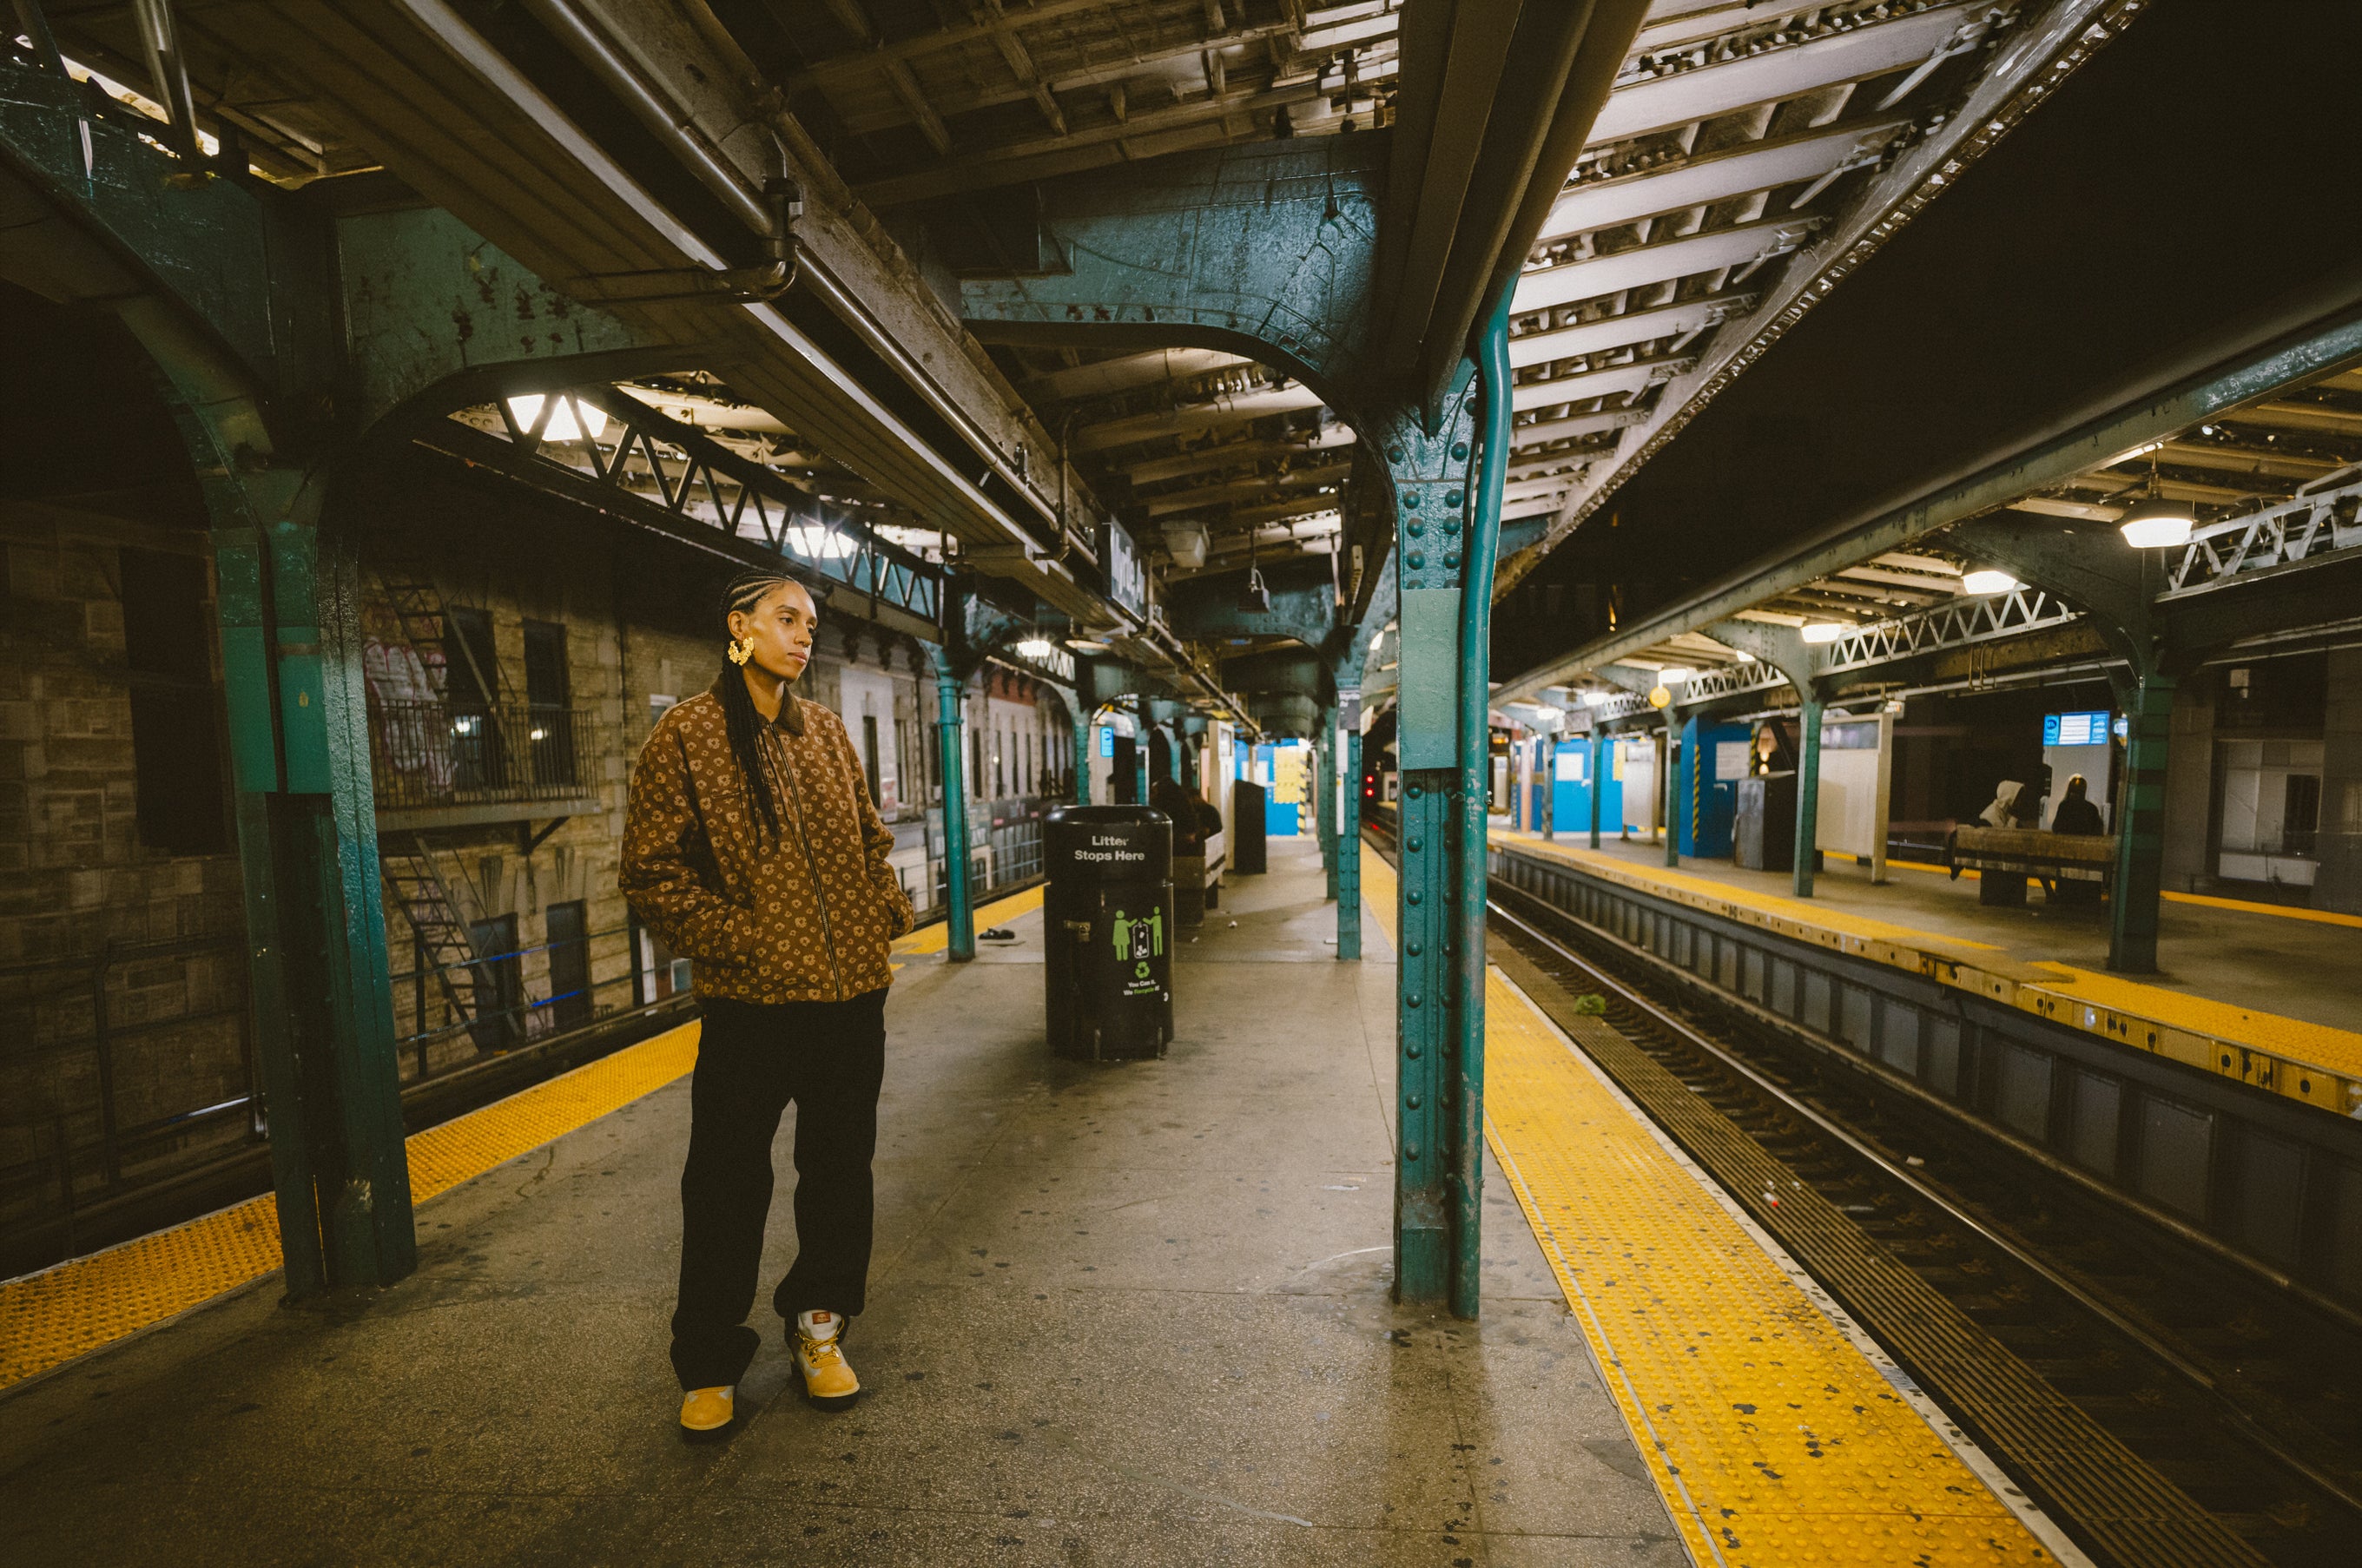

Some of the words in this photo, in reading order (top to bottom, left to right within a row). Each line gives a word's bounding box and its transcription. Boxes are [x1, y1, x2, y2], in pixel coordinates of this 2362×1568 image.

[1092, 835, 1129, 847] Litter
[1074, 850, 1112, 862] Stops
[1114, 850, 1145, 861] Here
